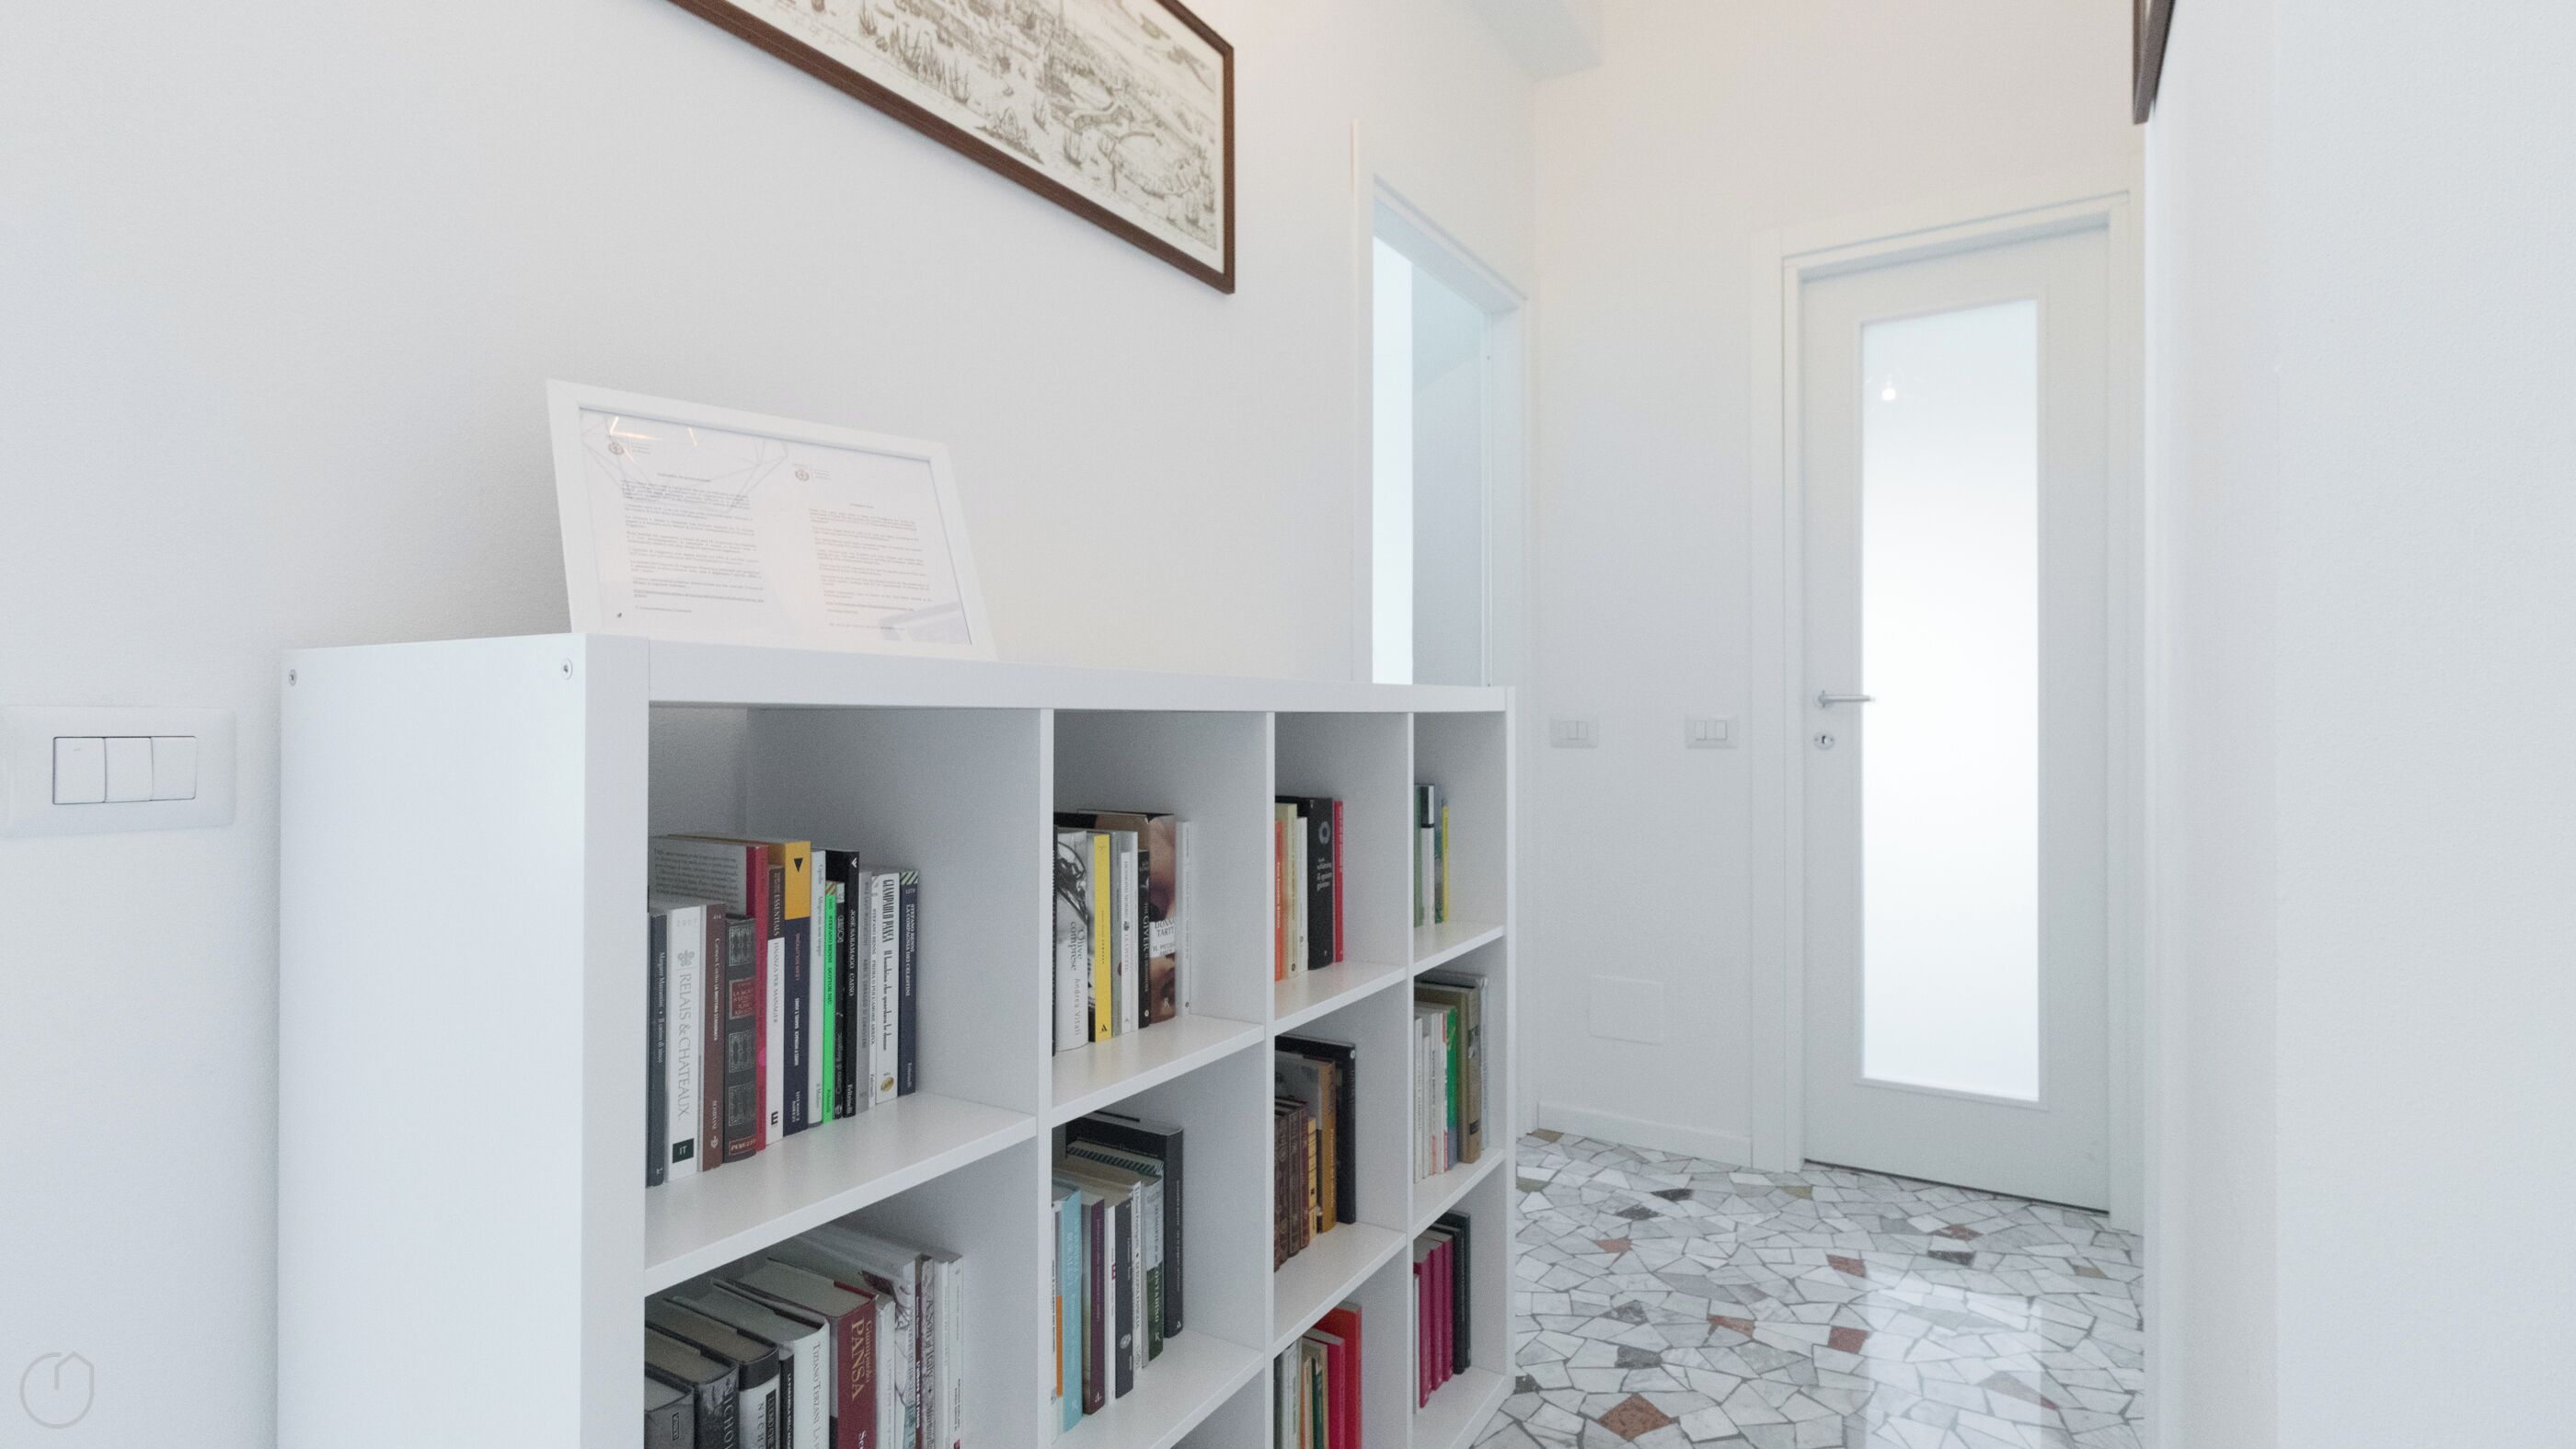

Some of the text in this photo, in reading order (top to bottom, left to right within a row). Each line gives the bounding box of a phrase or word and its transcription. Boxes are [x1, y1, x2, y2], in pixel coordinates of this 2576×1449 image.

[882, 880, 895, 943] GIAMPAOLO PANSA
[849, 928, 857, 969] SARAMAGO
[1068, 921, 1079, 972] comprese
[1077, 927, 1087, 960] Olive
[1142, 914, 1150, 952] GIVER
[657, 951, 666, 977] Margaret
[658, 977, 666, 1007] Mazzantini
[677, 972, 692, 1019] RELAIS
[1074, 977, 1082, 1037] Andrea Vitali
[677, 1022, 692, 1036] &
[846, 1083, 855, 1115] Feltrinelli
[679, 1144, 688, 1156] IT
[926, 1311, 935, 1340] Son
[812, 1340, 822, 1383] TIZIANO
[851, 1317, 865, 1402] PANSA
[864, 1319, 873, 1384] Giampaolo
[924, 1349, 935, 1378] Italy
[812, 1383, 822, 1425] TERZANI
